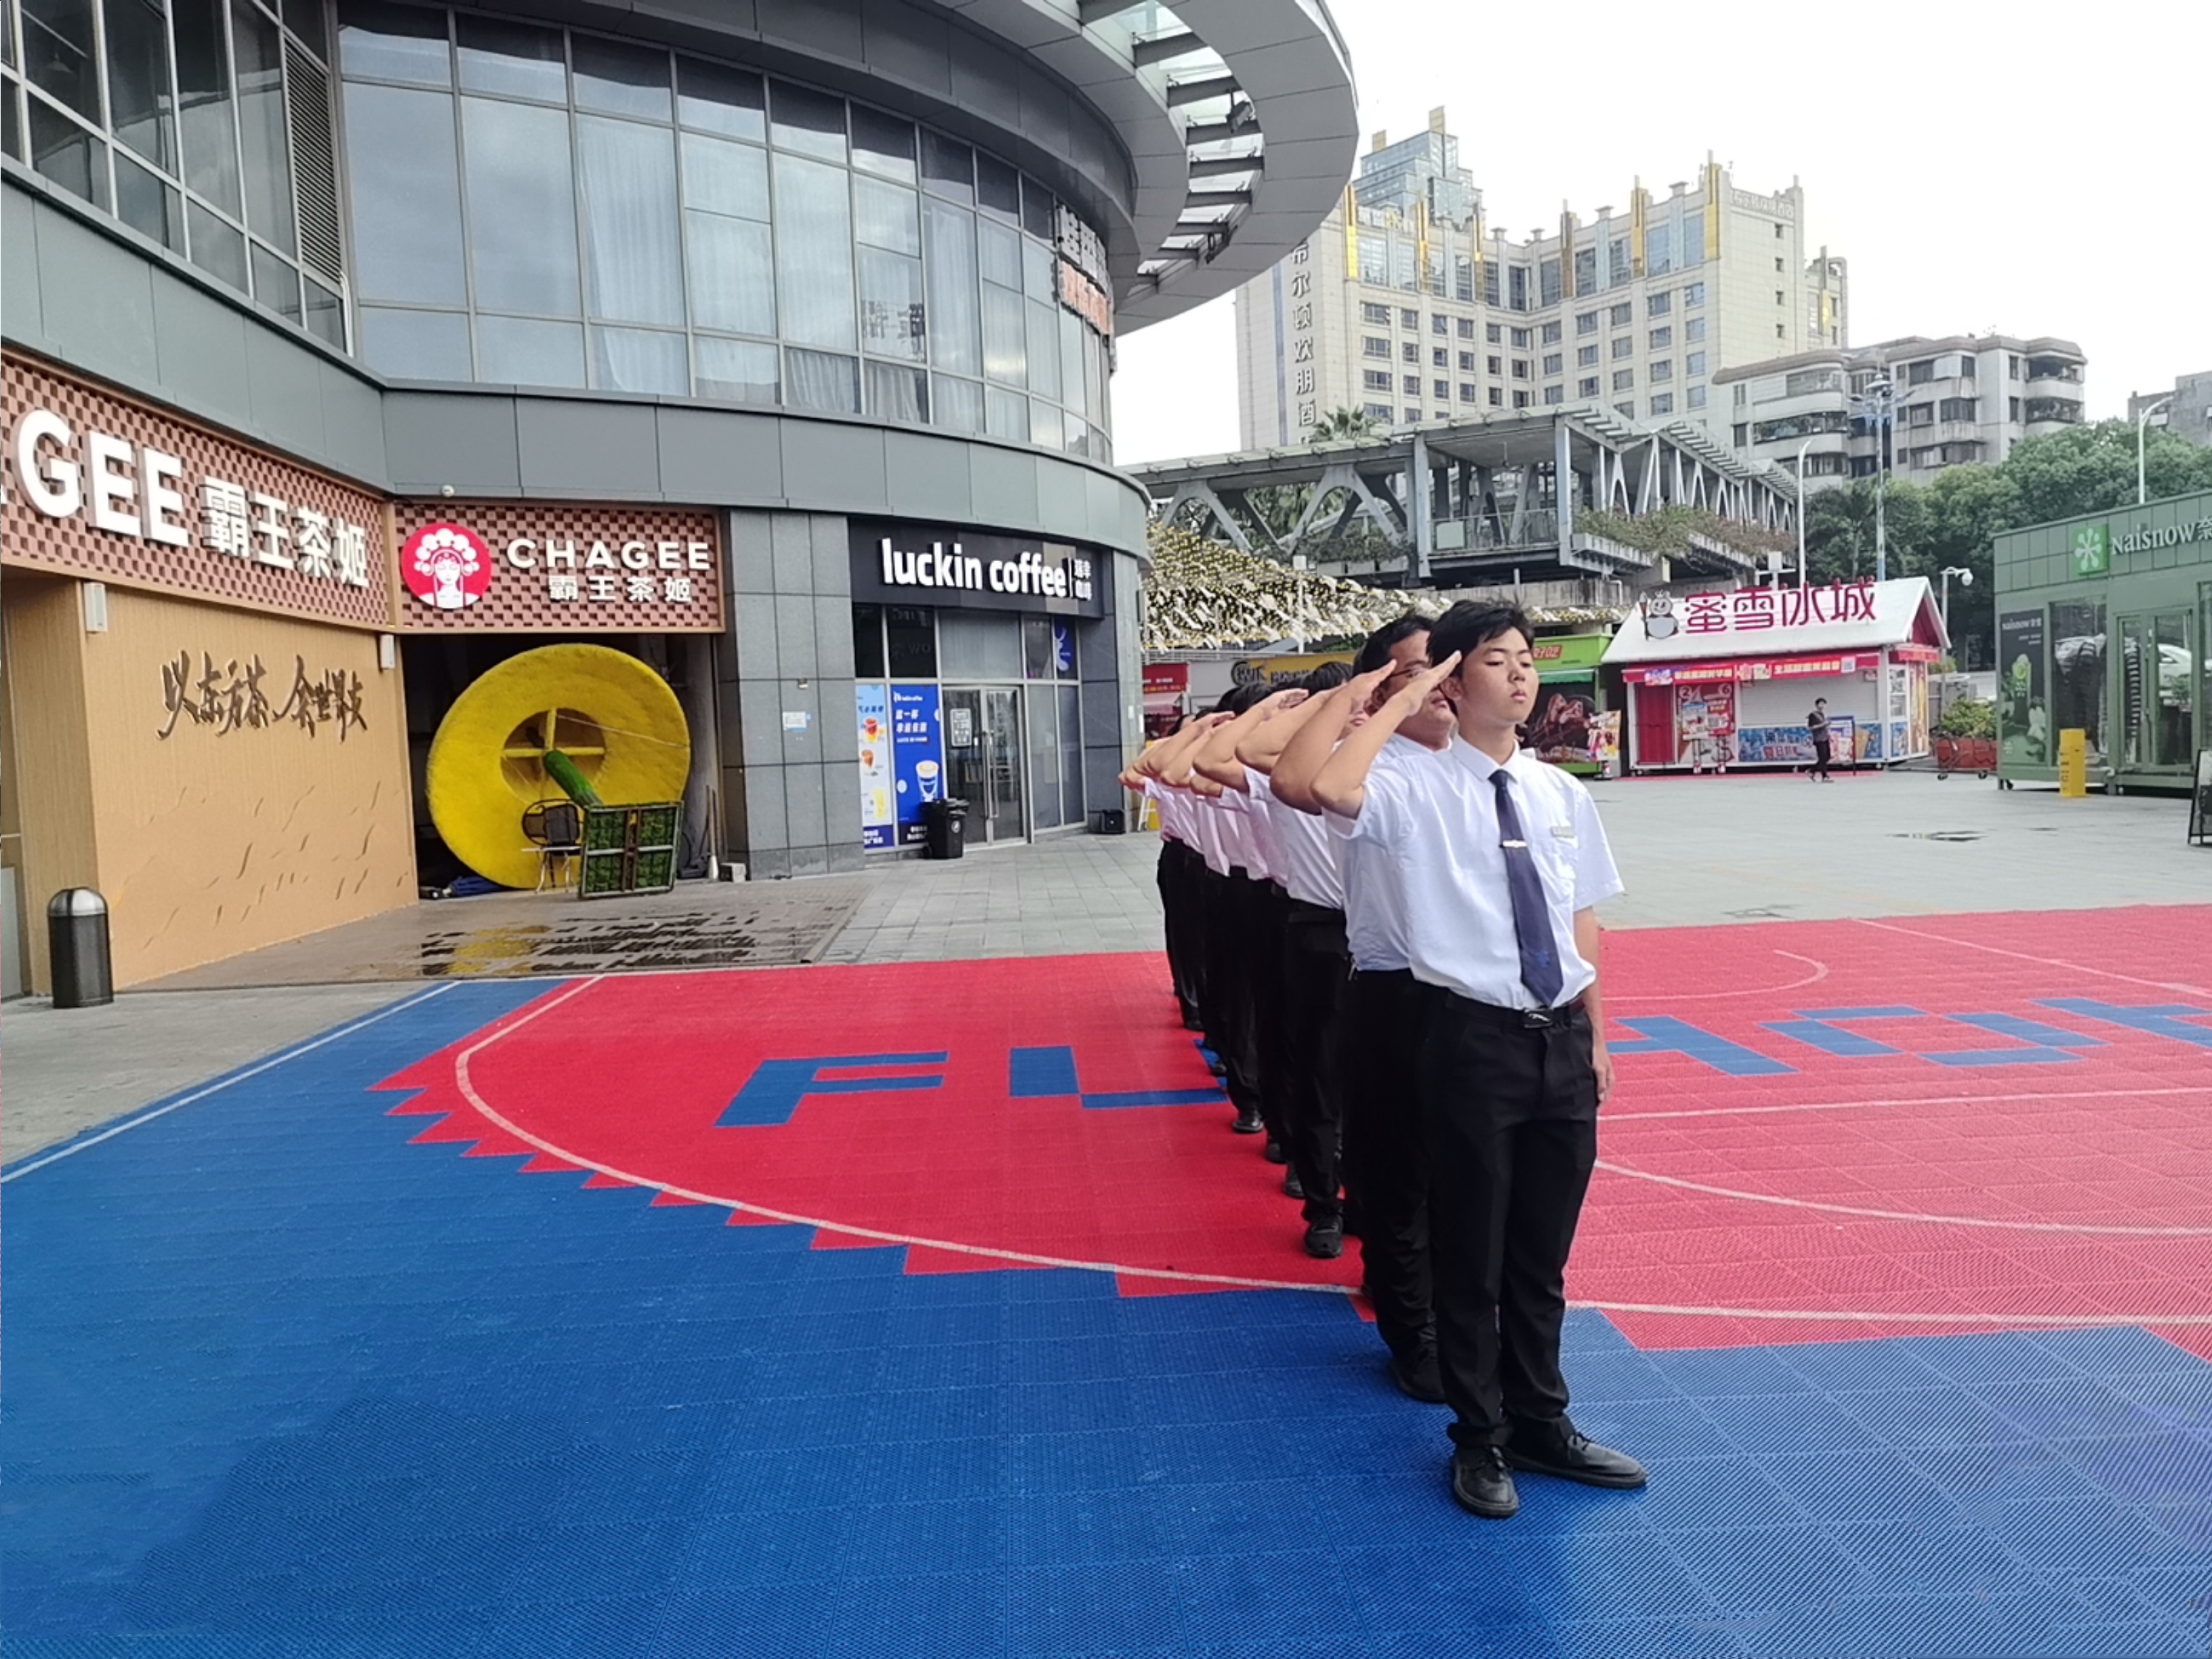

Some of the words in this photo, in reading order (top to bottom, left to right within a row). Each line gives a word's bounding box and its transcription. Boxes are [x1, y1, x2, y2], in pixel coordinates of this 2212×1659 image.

[0, 409, 188, 547] GEE
[202, 475, 369, 588] 霸王茶姬
[506, 539, 711, 570] CHAGEE
[2112, 523, 2195, 556] Naisnow
[548, 575, 692, 603] 霸王茶姬
[882, 538, 983, 590] luckin
[989, 552, 1067, 598] coffee
[1685, 575, 1877, 634] 蜜雪冰城
